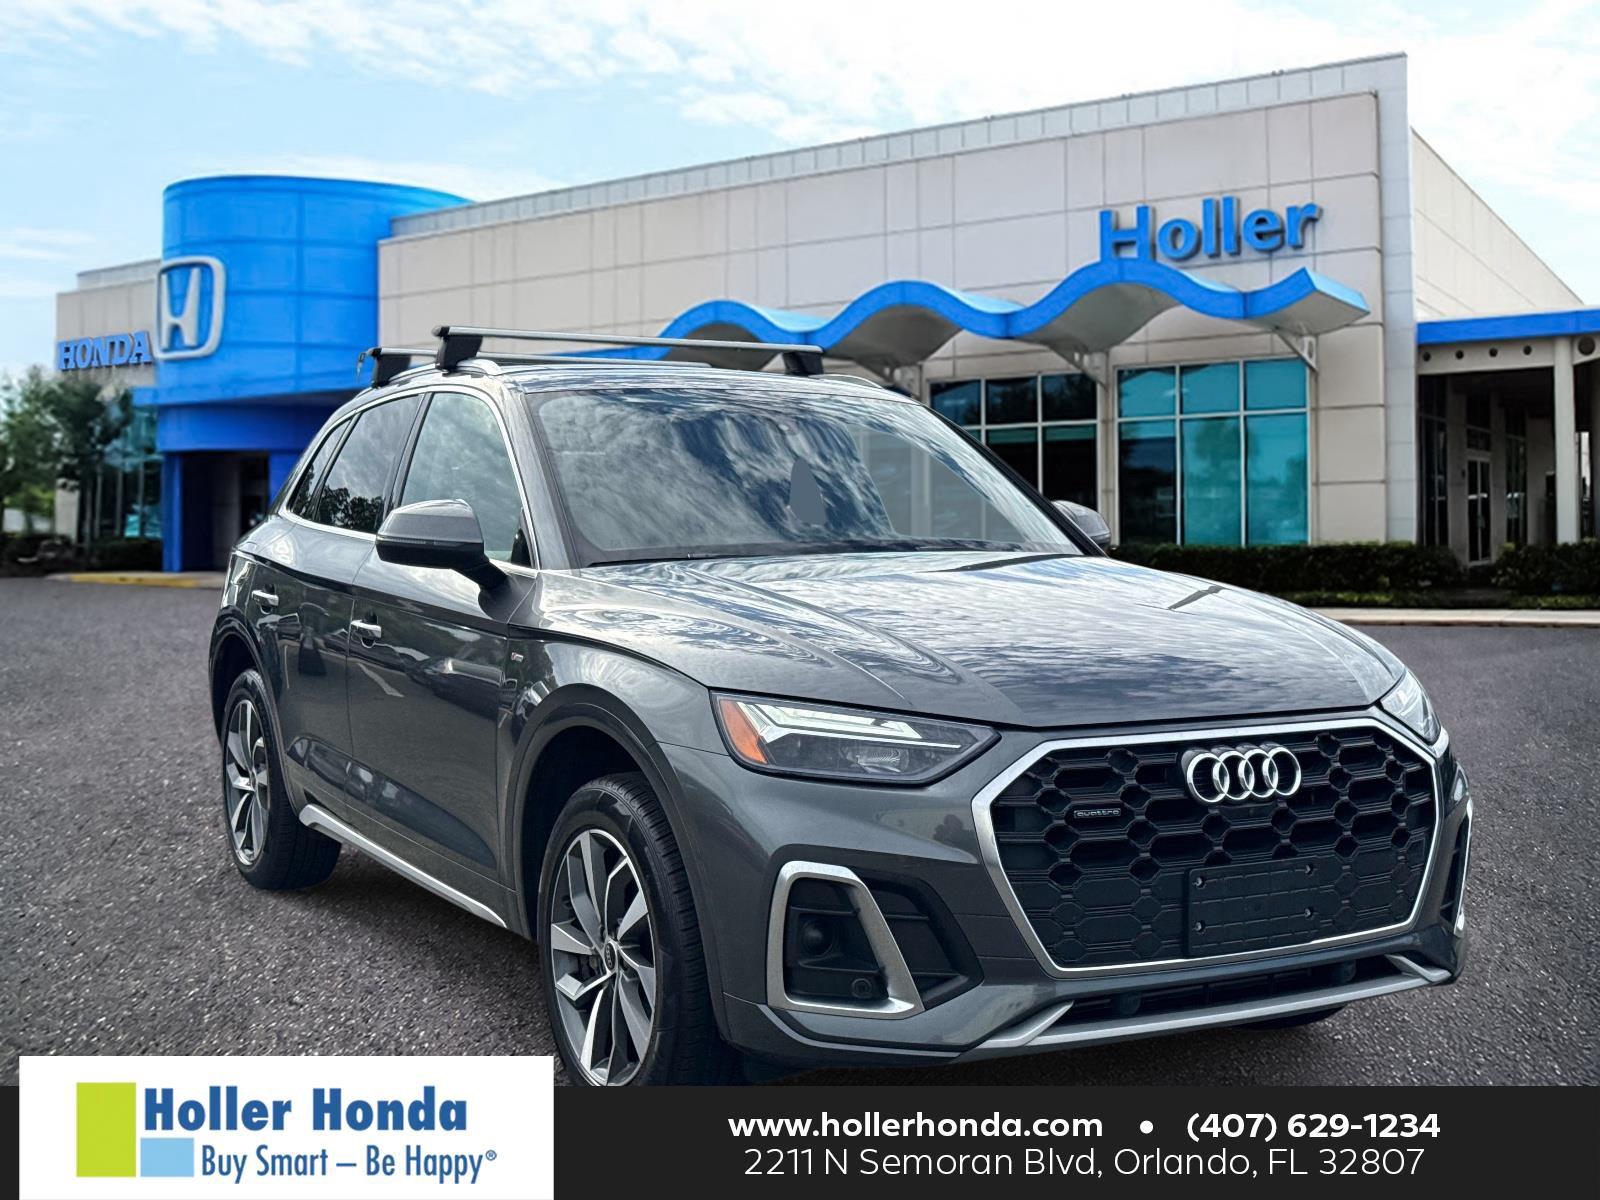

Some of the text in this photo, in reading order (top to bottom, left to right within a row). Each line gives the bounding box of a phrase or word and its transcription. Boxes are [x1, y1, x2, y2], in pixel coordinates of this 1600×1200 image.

[1099, 195, 1322, 261] Holler
[58, 330, 152, 371] HONDA
[1075, 809, 1120, 817] quattro
